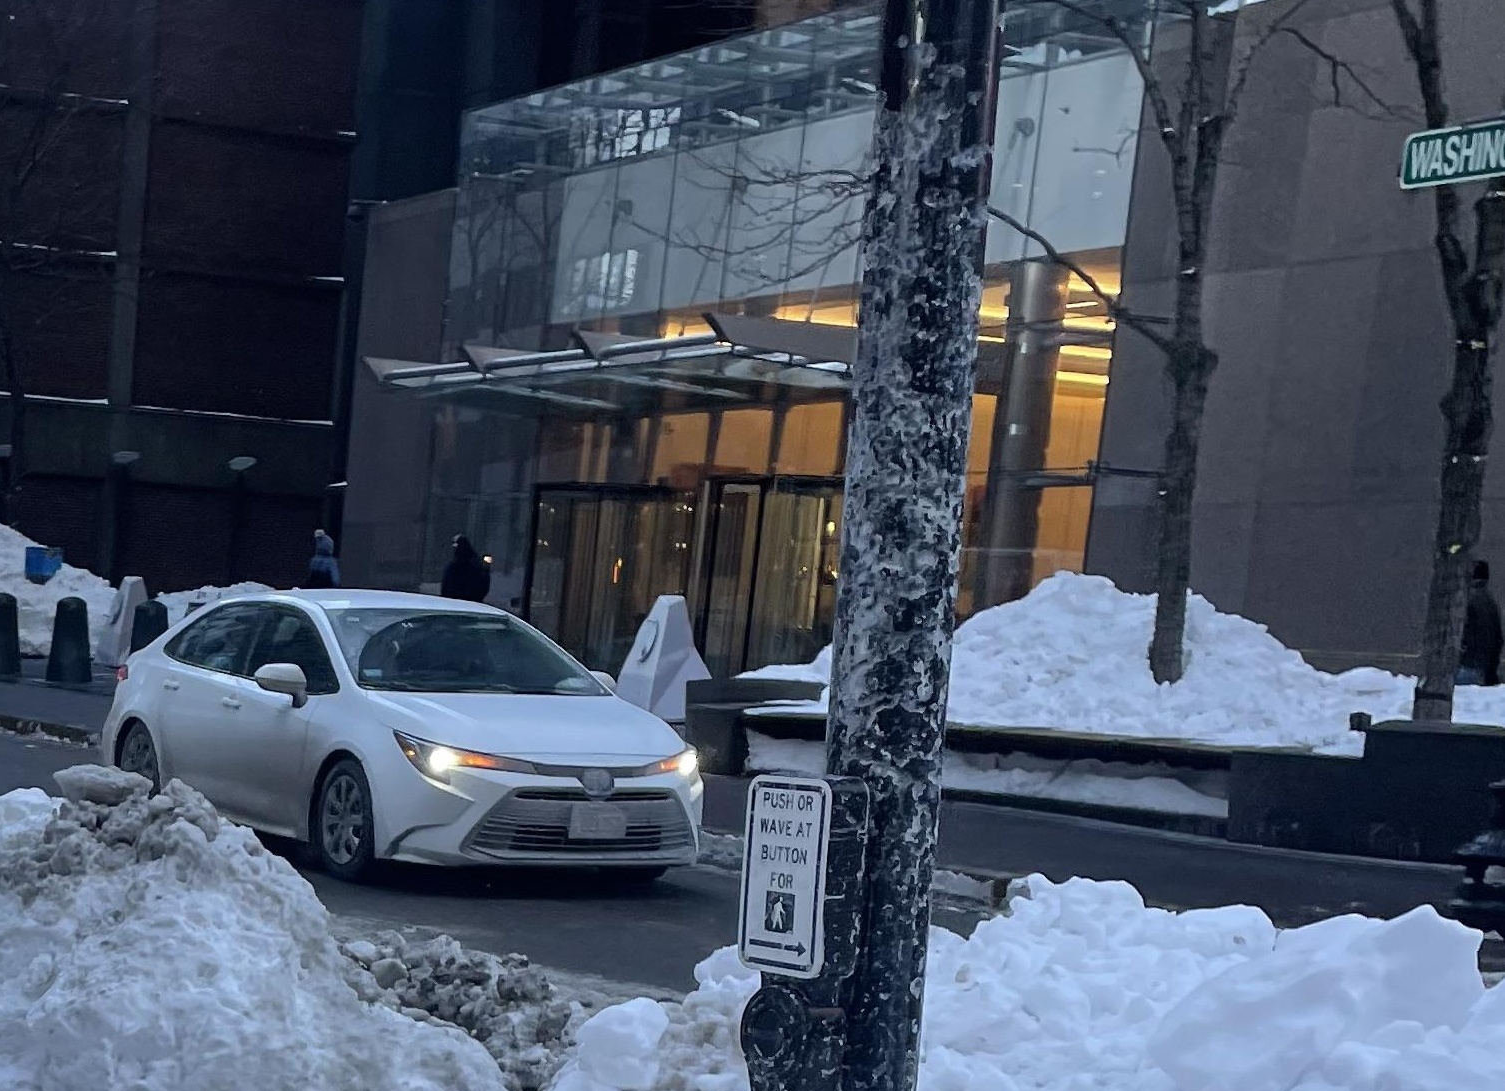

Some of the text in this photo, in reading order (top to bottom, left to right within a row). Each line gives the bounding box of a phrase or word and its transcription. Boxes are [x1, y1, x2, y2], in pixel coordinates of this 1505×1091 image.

[763, 791, 814, 811] PUSH OR
[760, 818, 813, 838] WAVE AT
[761, 844, 808, 865] BUTTON
[770, 872, 793, 889] FOR
